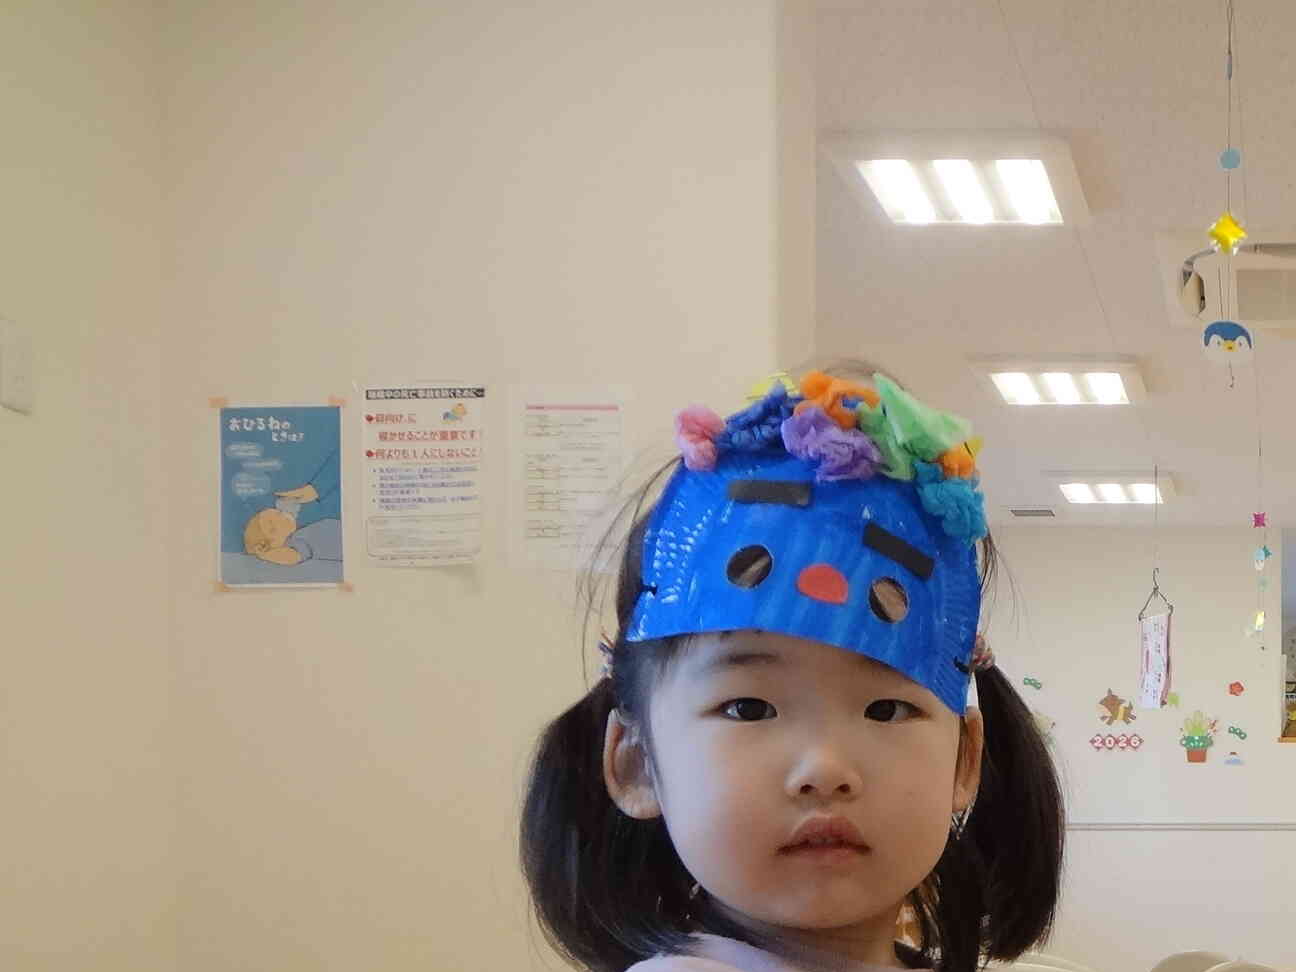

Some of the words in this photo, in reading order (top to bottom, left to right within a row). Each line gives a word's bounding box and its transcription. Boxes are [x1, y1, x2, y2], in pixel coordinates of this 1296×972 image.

[228, 415, 291, 431] おひるねの
[1093, 735, 1141, 749] 2026
